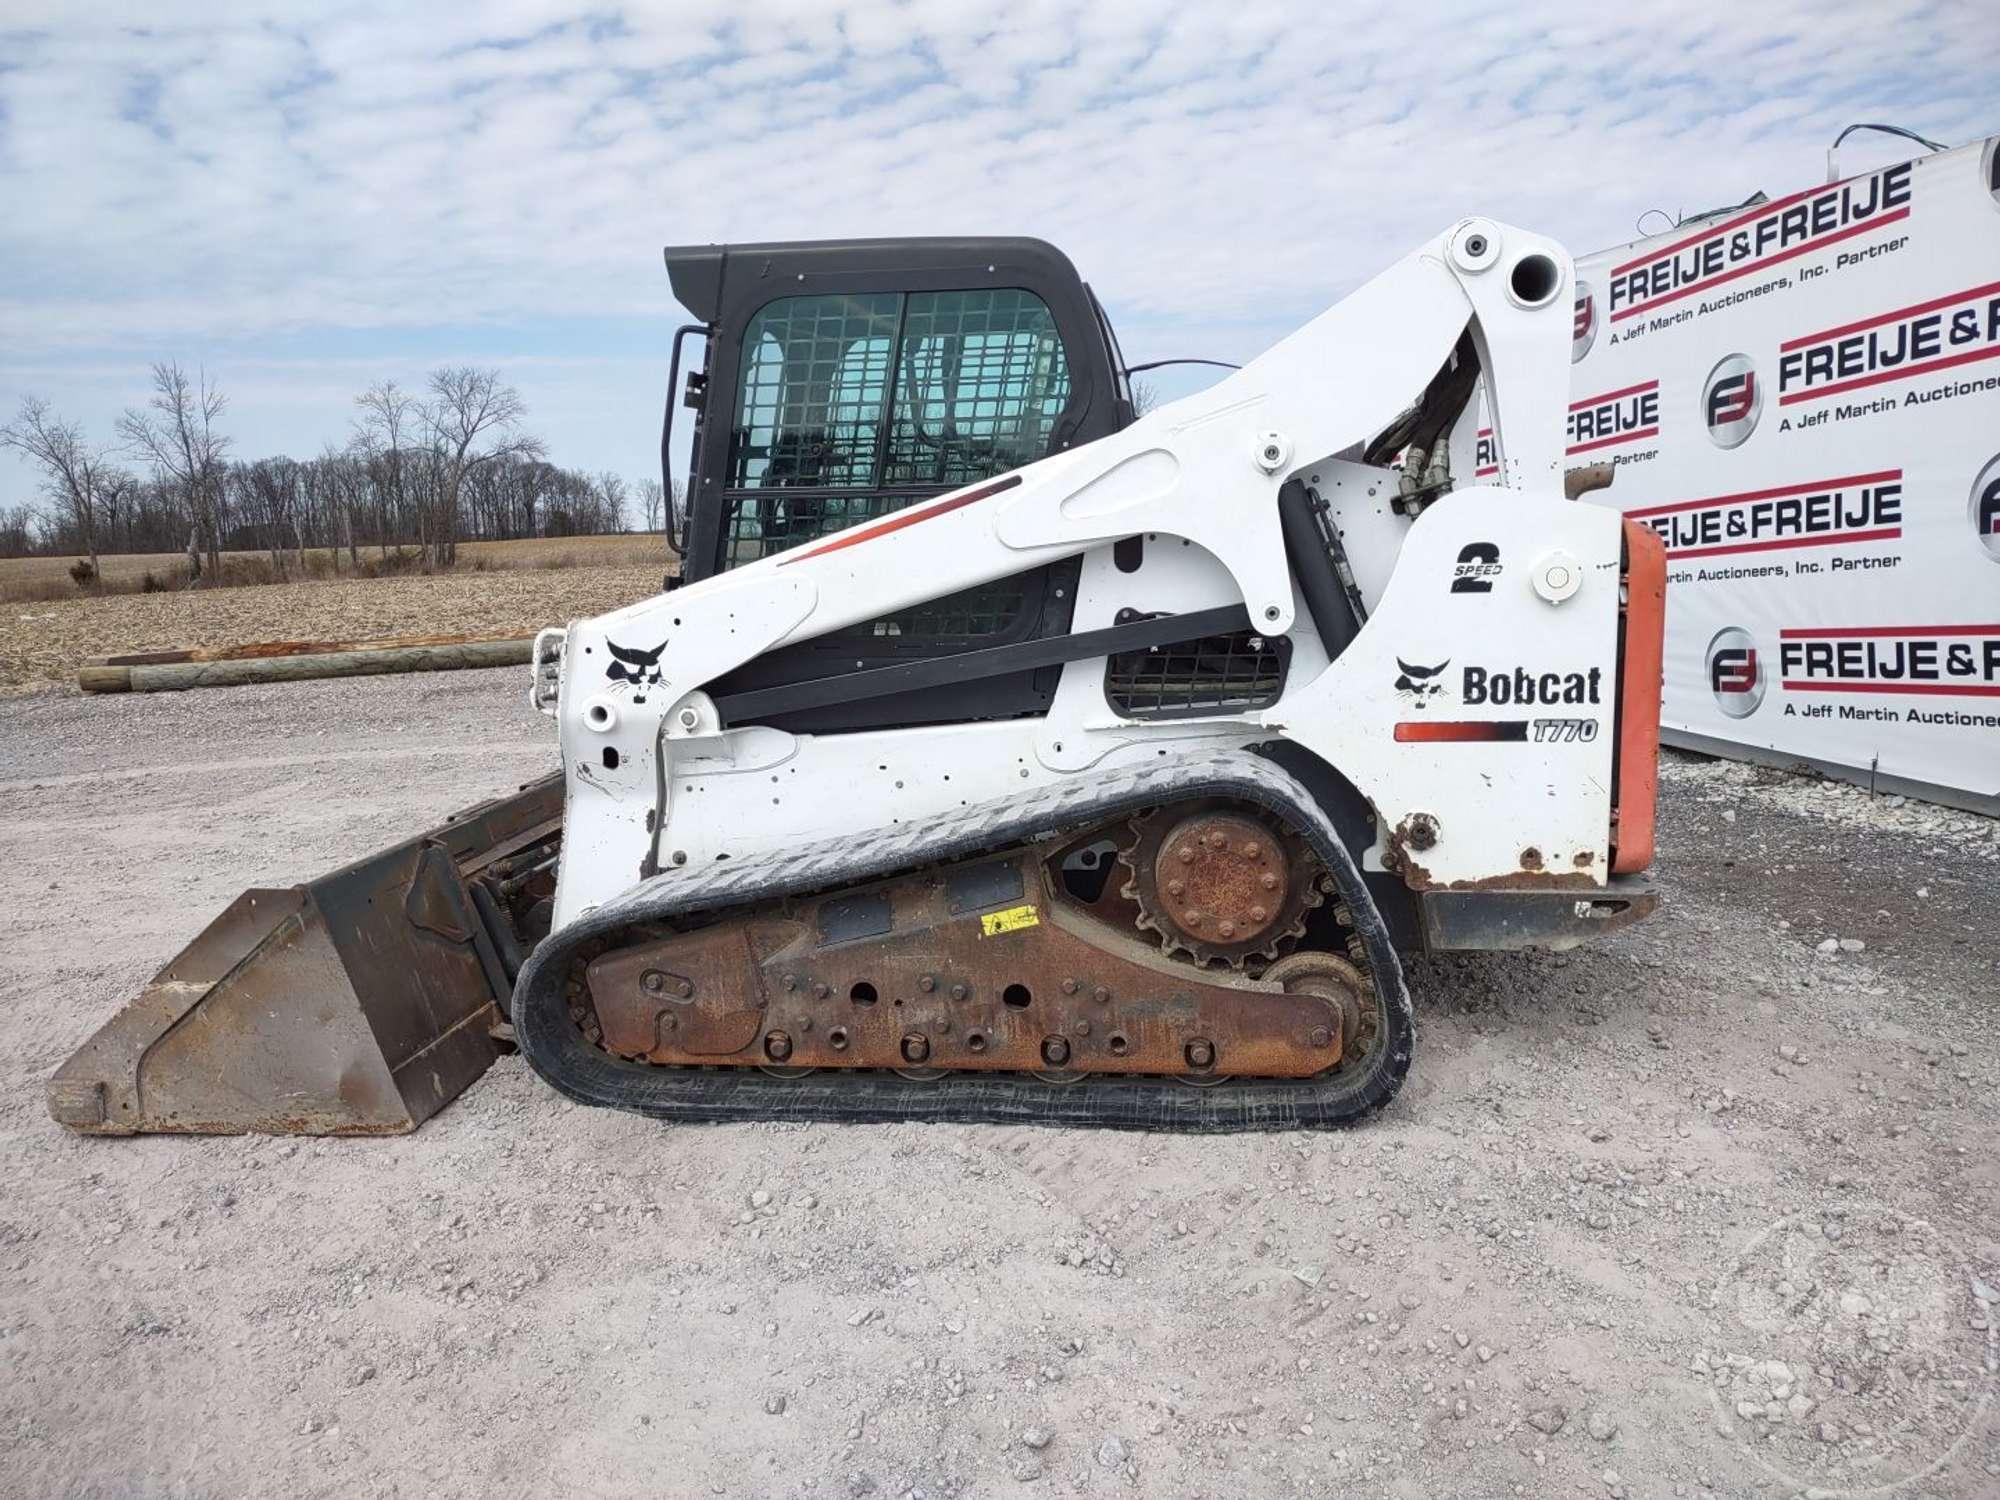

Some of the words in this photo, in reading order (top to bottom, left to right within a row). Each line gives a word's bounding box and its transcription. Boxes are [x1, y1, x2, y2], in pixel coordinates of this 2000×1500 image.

[1609, 333, 1619, 345] A
[1623, 320, 1646, 342] Jeff
[1650, 309, 1694, 332] Martin
[1698, 276, 1793, 316] Auctioneers,
[1800, 265, 1829, 282] Inc.
[1836, 236, 1910, 269] Partner
[1779, 419, 1791, 432] A
[1797, 410, 1830, 429] Jeff
[1836, 397, 1896, 421] Martin
[1904, 376, 2000, 407] Auctione
[1451, 542, 1500, 593] 2
[1454, 564, 1503, 577] SPEED
[1666, 570, 1693, 584] rtin
[1697, 565, 1789, 582] Auctioneers,
[1796, 560, 1824, 574] Inc.
[1832, 555, 1902, 571] Partner
[1463, 666, 1601, 705] Bobcat
[1533, 718, 1598, 743] T770
[1784, 703, 1796, 716] A
[1801, 703, 1833, 718] Jeff
[1839, 705, 1899, 722] Martin
[1906, 708, 2000, 727] Auctione
